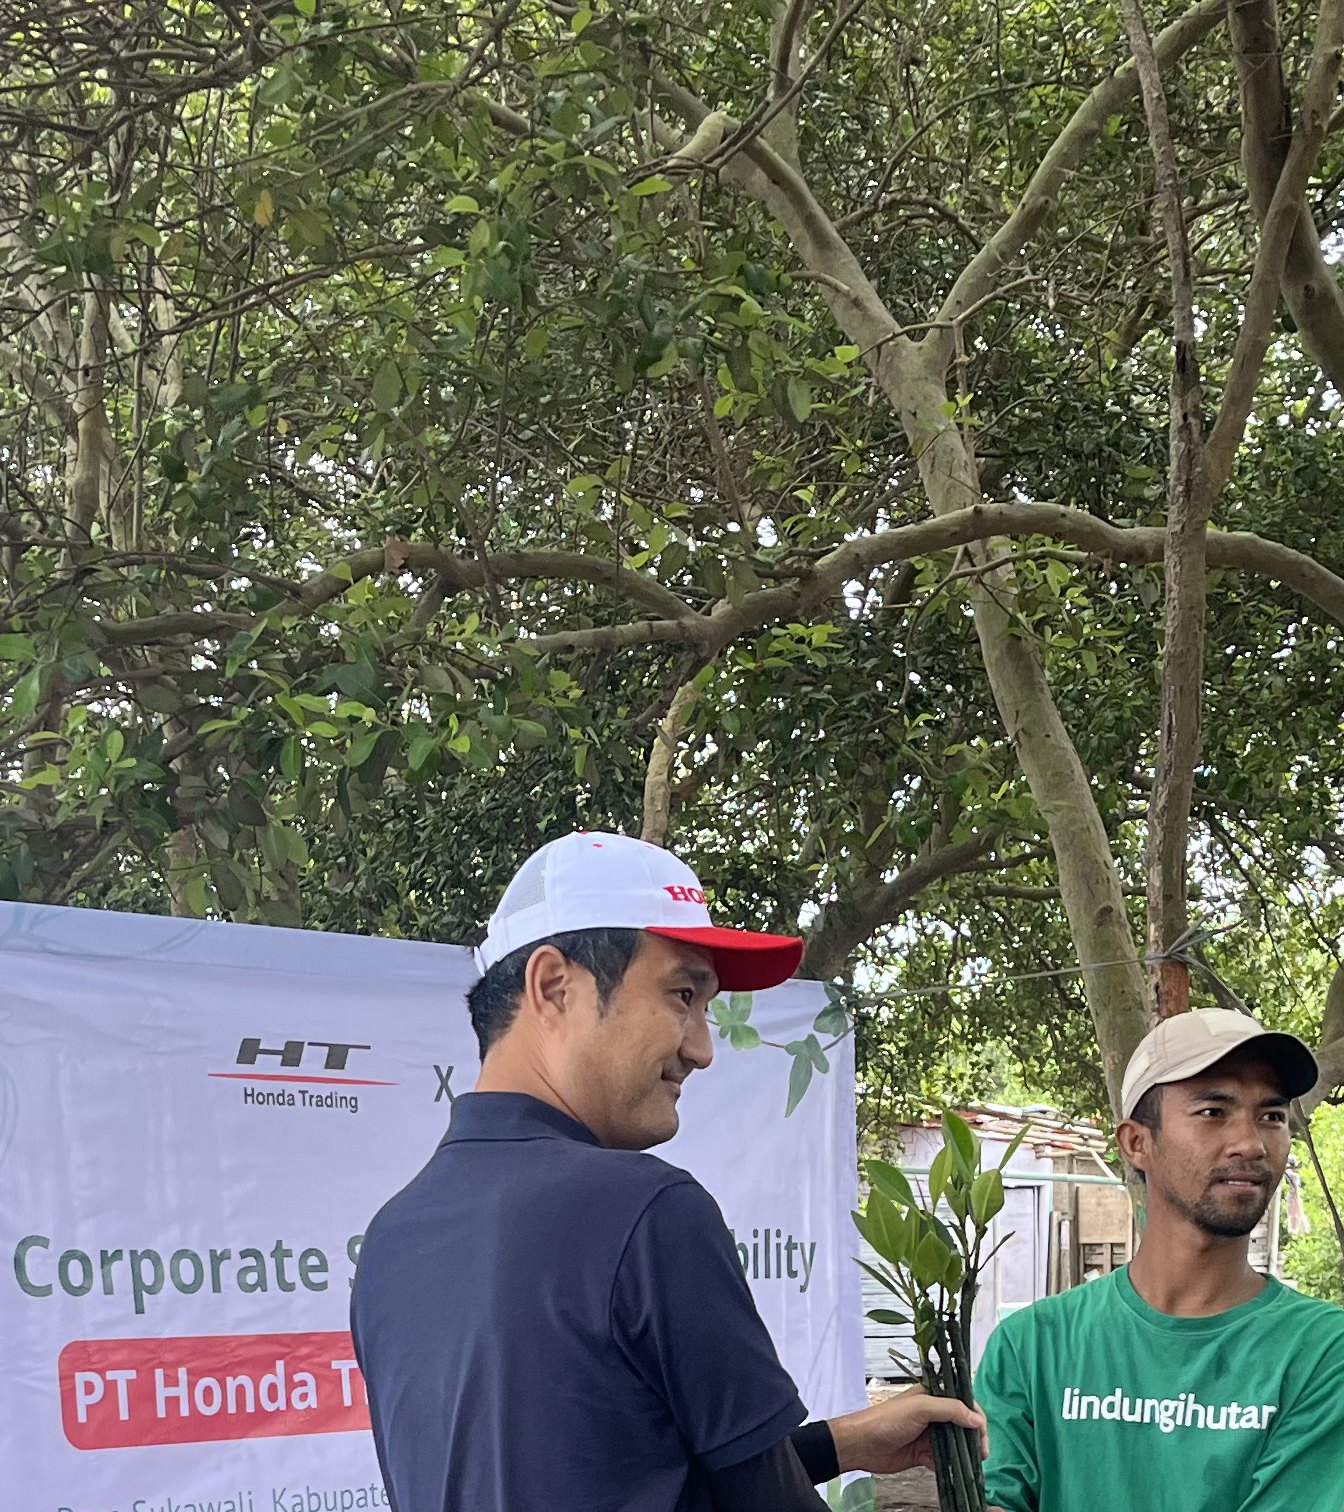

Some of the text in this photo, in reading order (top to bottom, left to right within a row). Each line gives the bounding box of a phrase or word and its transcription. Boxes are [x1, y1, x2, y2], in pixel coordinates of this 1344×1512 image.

[236, 1038, 371, 1070] HT
[244, 1087, 359, 1114] Honda Trading
[13, 1234, 330, 1315] Corporate
[75, 1359, 369, 1423] PT Honda T
